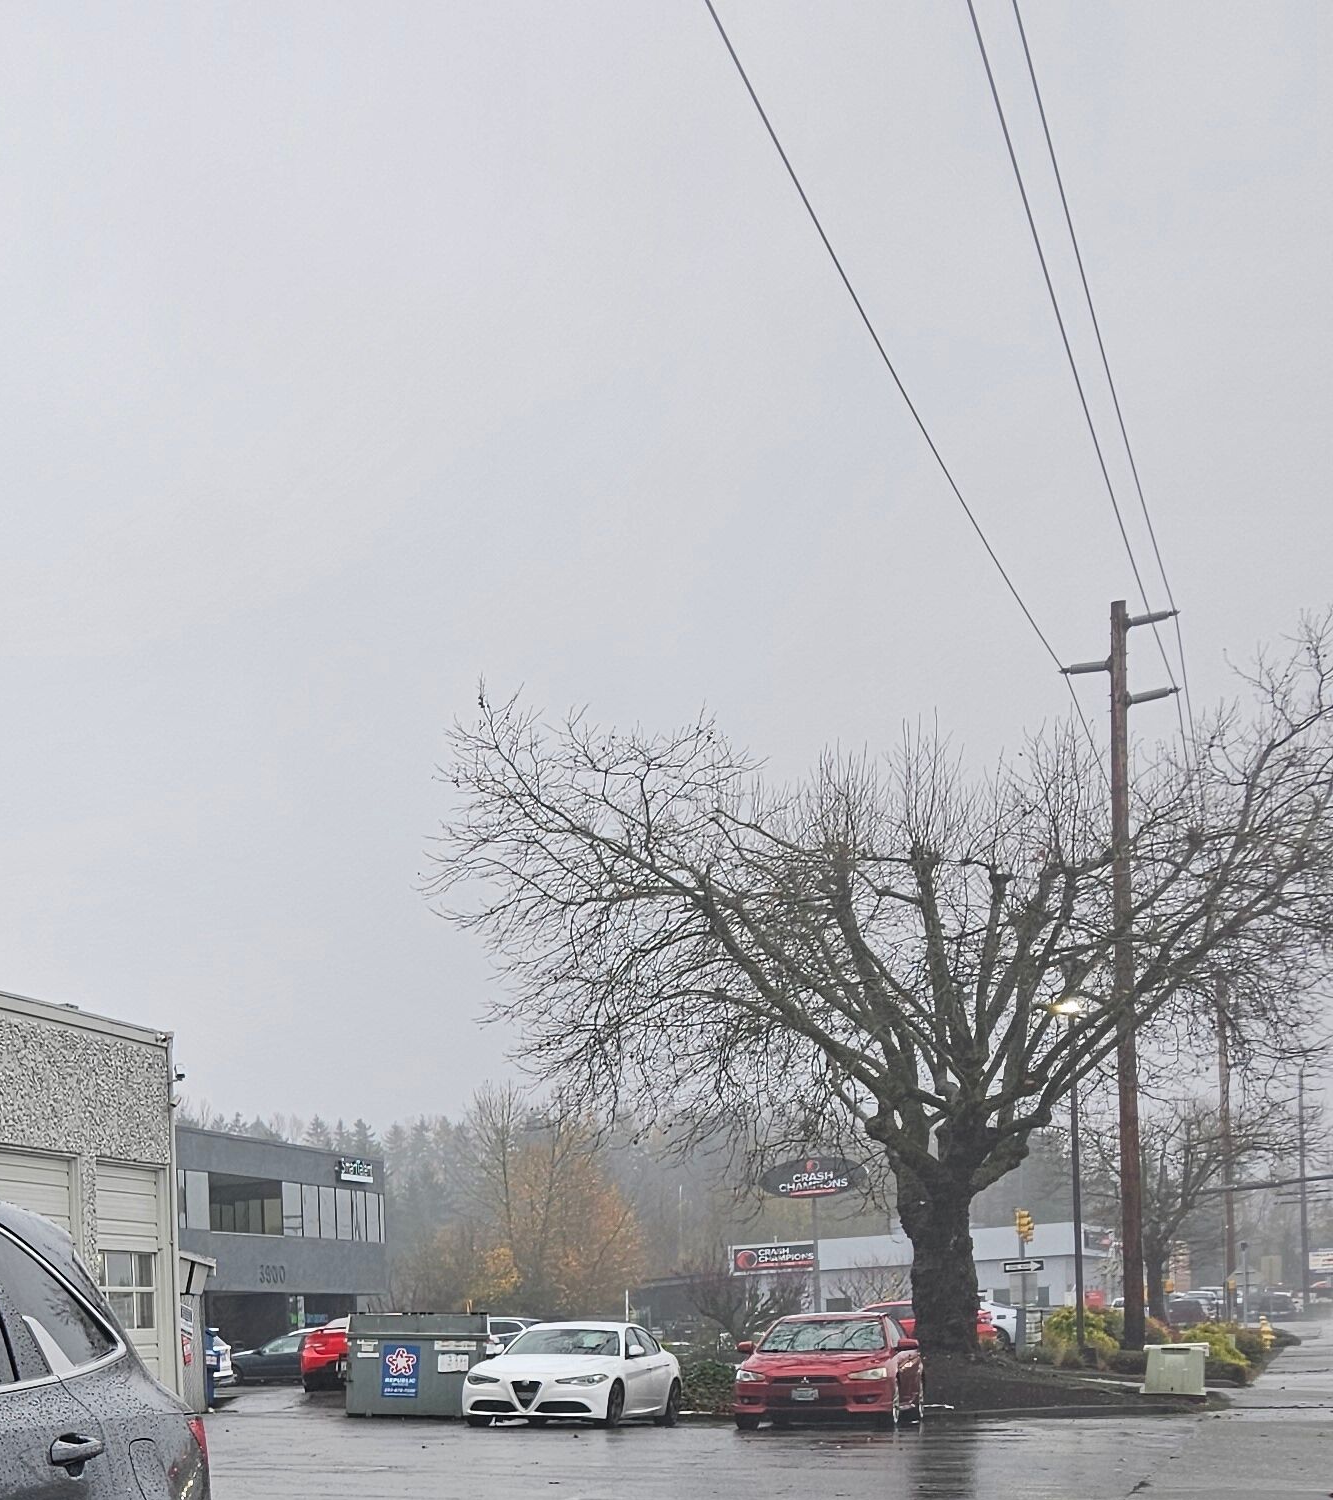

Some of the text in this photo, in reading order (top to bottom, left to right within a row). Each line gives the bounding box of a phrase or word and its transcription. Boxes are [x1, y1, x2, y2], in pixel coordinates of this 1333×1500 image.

[792, 1171, 834, 1183] CRASH
[778, 1177, 849, 1193] CHAMPIONS
[758, 1247, 790, 1256] CRASH
[758, 1252, 814, 1263] CHAMPIONS
[259, 1264, 286, 1284] 3900
